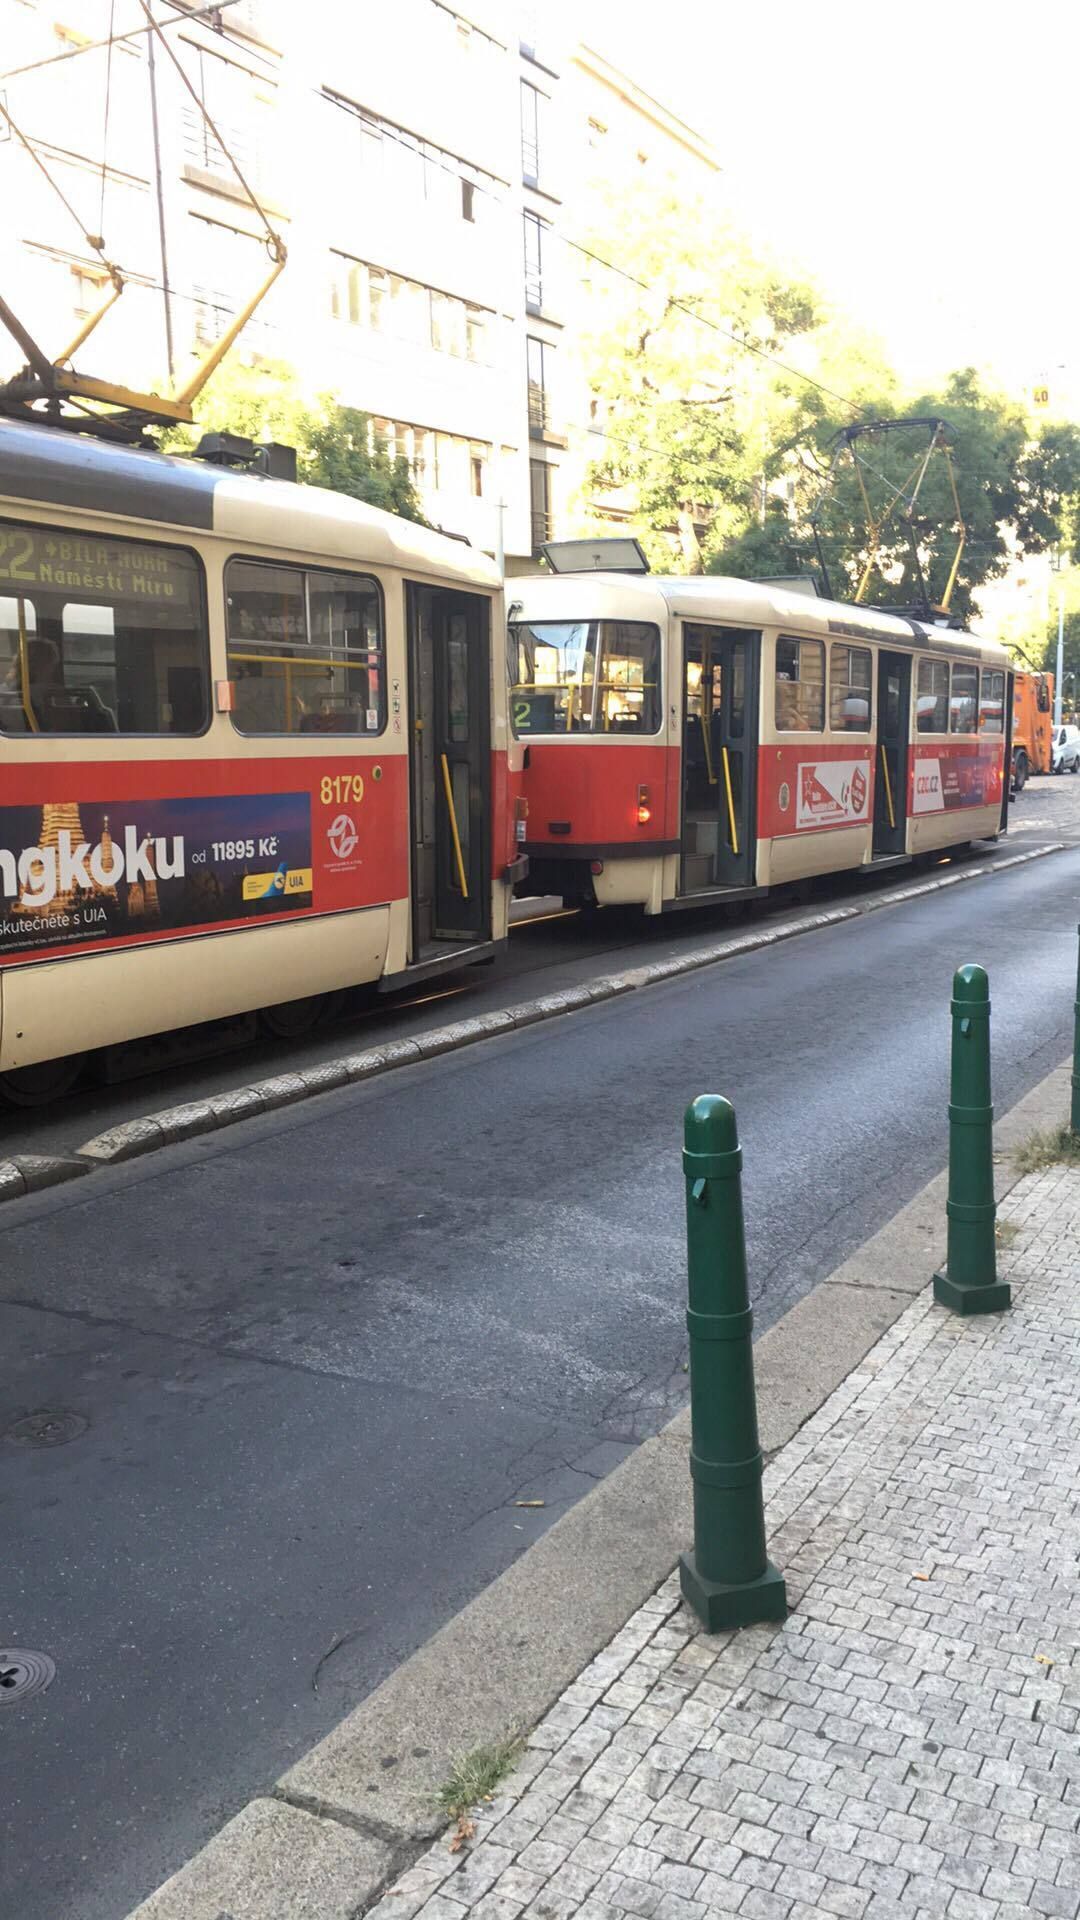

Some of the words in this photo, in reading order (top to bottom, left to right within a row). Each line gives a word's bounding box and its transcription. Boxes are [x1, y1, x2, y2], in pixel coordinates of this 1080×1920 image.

[320, 774, 364, 805] 8179
[0, 825, 185, 907] ngkoku
[191, 849, 206, 864] od
[211, 839, 255, 862] 11895
[288, 875, 304, 888] UIA
[73, 913, 80, 925] s
[83, 907, 107, 923] UIA
